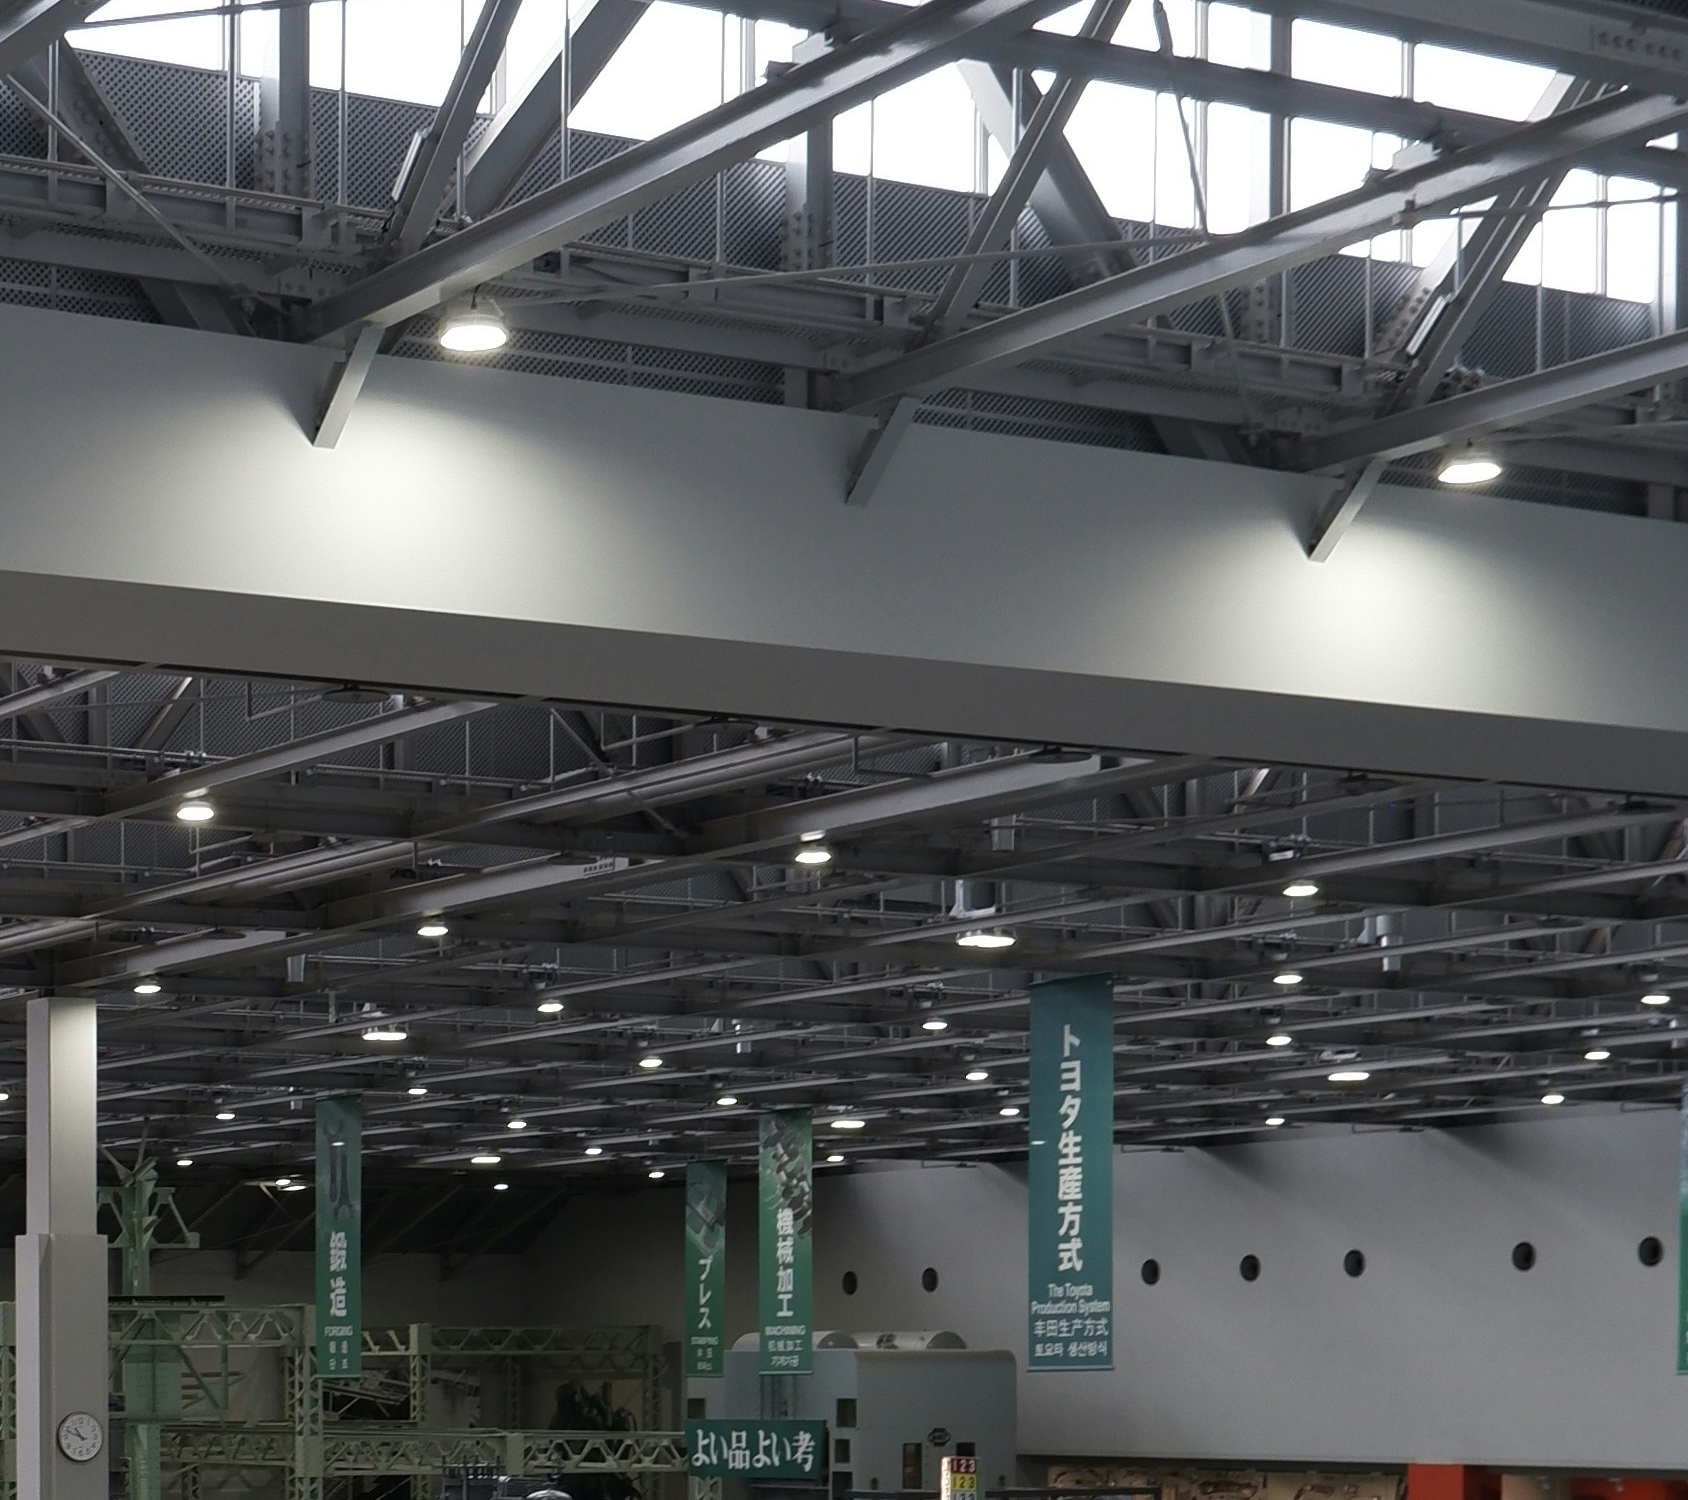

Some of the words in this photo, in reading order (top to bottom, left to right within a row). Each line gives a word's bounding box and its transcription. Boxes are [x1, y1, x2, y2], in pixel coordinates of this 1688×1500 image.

[1058, 1024, 1083, 1272] トヨタ生産方式
[776, 1208, 794, 1317] 機械加工
[698, 1255, 713, 1329] プレス
[1031, 1300, 1077, 1315] Production
[1078, 1300, 1110, 1316] System
[1048, 1283, 1065, 1298] The
[1067, 1283, 1093, 1299] Toyota
[324, 1326, 354, 1337] FORGING
[692, 1429, 816, 1473] よい品よい考
